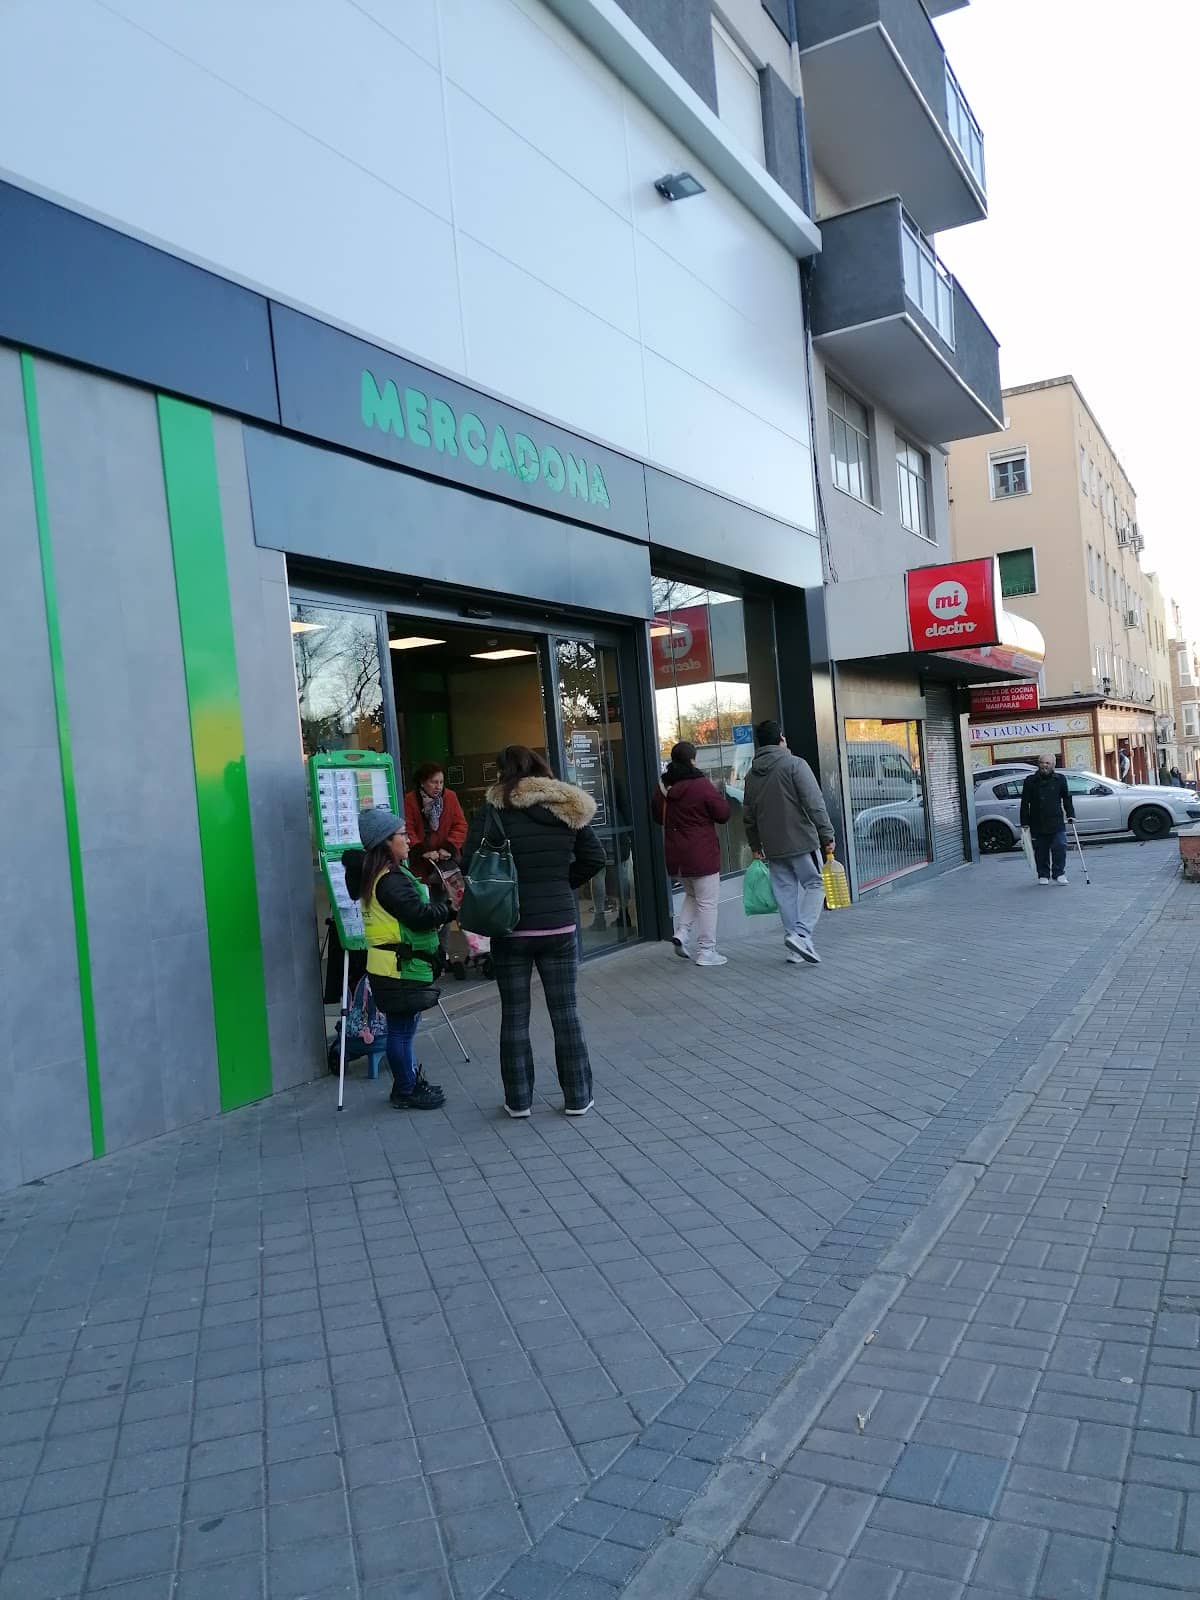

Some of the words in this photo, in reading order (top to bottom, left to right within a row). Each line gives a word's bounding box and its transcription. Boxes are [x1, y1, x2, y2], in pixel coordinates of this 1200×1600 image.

[361, 368, 610, 510] MERCADONA
[935, 589, 962, 609] mi
[925, 621, 977, 638] electro
